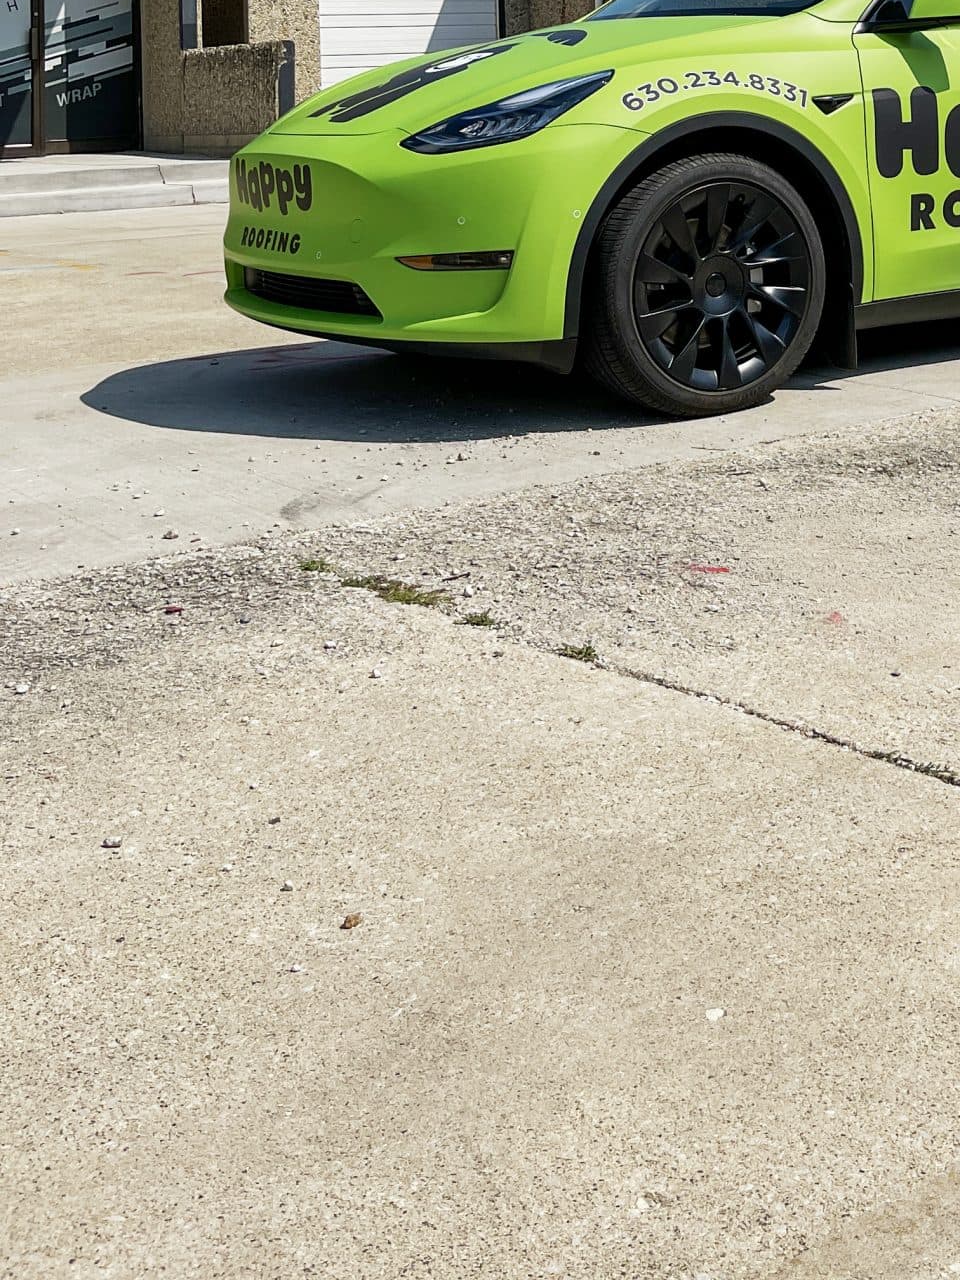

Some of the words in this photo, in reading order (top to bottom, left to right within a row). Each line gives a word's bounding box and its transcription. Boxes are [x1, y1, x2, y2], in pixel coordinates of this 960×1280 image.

[56, 82, 103, 107] WRAP
[621, 71, 808, 111] 630.234.8331
[235, 157, 313, 216] Happy
[240, 226, 302, 255] ROOFING
